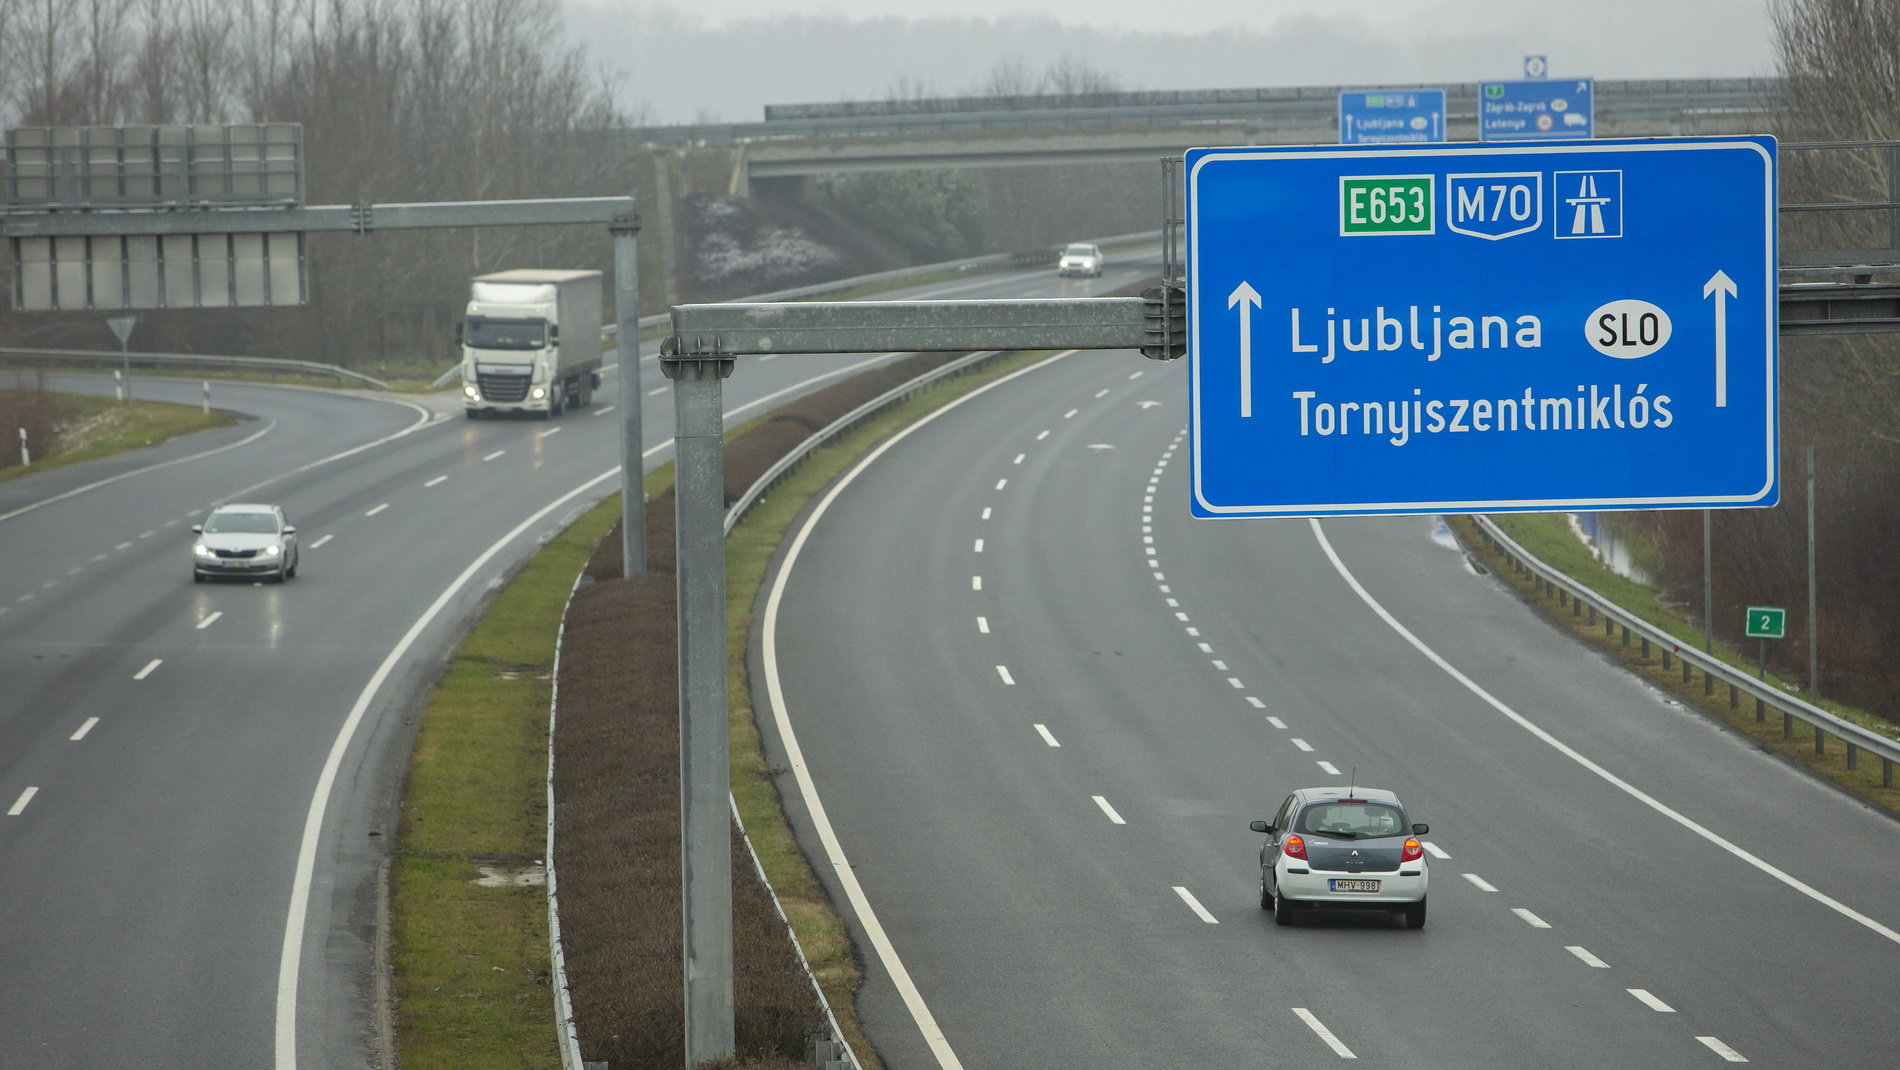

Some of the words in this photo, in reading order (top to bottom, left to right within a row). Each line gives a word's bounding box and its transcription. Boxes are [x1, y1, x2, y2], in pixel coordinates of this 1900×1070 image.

[1485, 118, 1526, 131] Letenye
[1350, 187, 1425, 224] E653
[1458, 184, 1531, 223] M70
[1290, 305, 1542, 363] Ljubljana
[1598, 312, 1659, 347] SLO
[1292, 383, 1674, 447] Tornyiszentmiklós
[1760, 615, 1770, 630] 2
[1337, 881, 1377, 890] MHV-998
